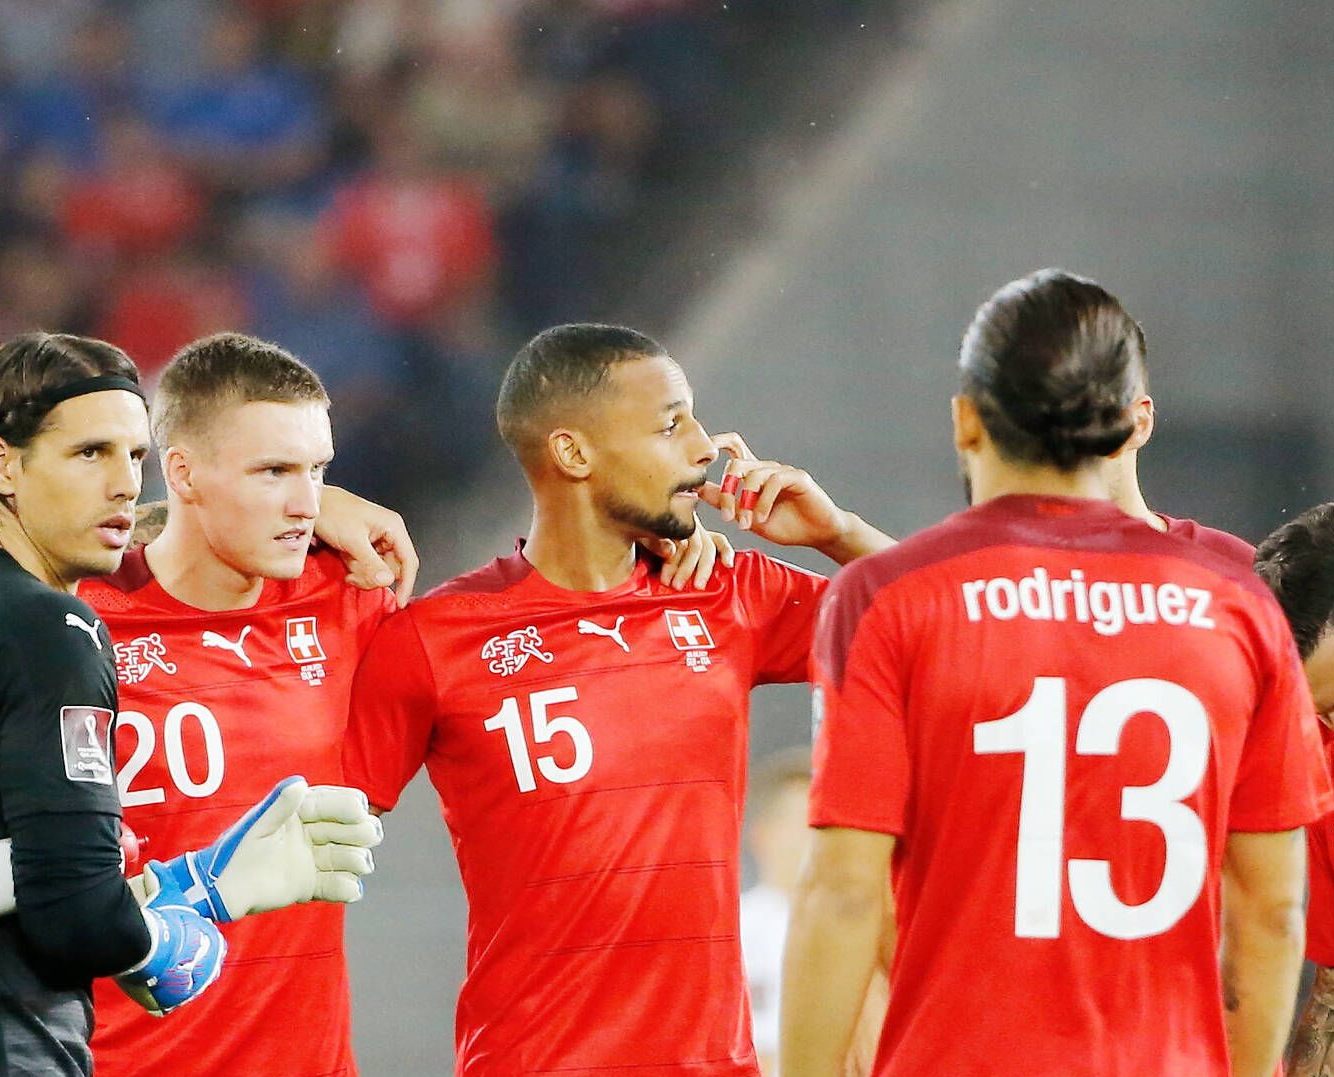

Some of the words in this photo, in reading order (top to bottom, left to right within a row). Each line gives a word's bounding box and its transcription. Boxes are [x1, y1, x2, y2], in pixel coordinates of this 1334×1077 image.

[962, 567, 1216, 635] rodriguez
[115, 702, 226, 808] 20
[483, 686, 594, 793] 15
[973, 676, 1210, 940] 13
